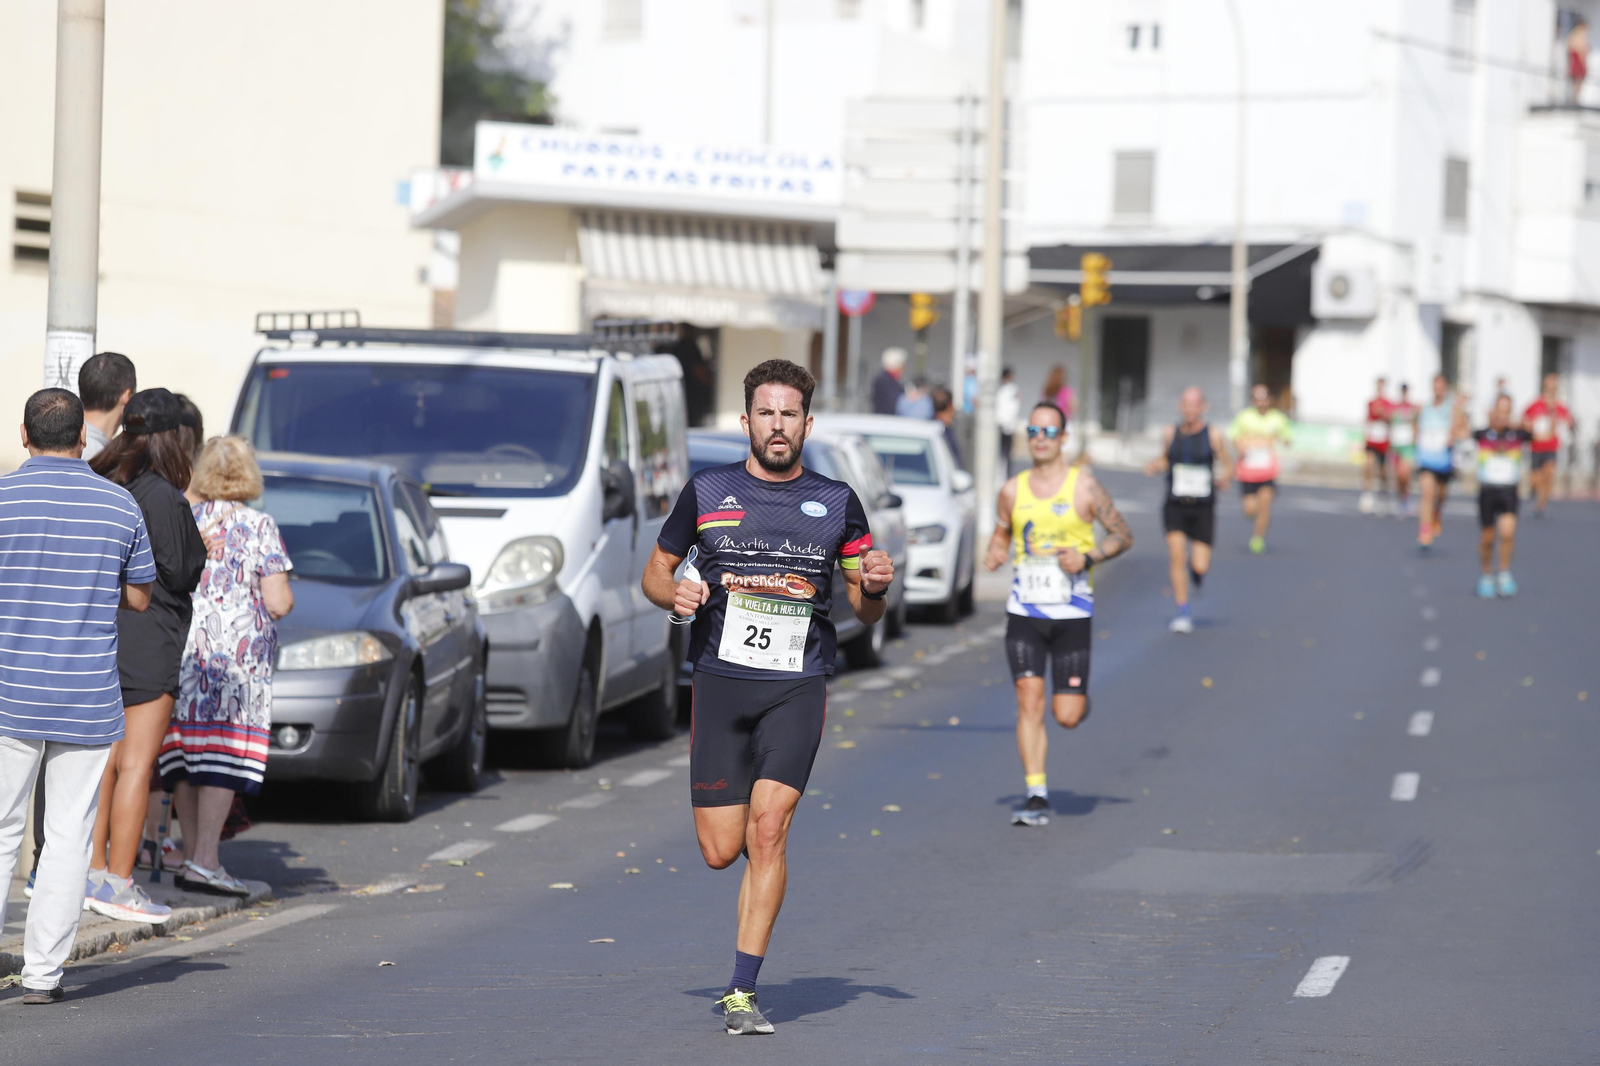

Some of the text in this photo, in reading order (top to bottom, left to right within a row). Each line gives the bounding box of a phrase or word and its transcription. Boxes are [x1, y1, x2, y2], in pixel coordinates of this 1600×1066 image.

[521, 136, 664, 160] CHURROS
[561, 163, 815, 195] PATATAS FRITAS
[718, 561, 821, 574] www.joyeriamartinauden.com
[720, 571, 787, 588] Florencia
[734, 596, 807, 616] 34 VUELTA A HUELVA
[745, 611, 773, 621] ANTONIO
[743, 624, 772, 650] 25
